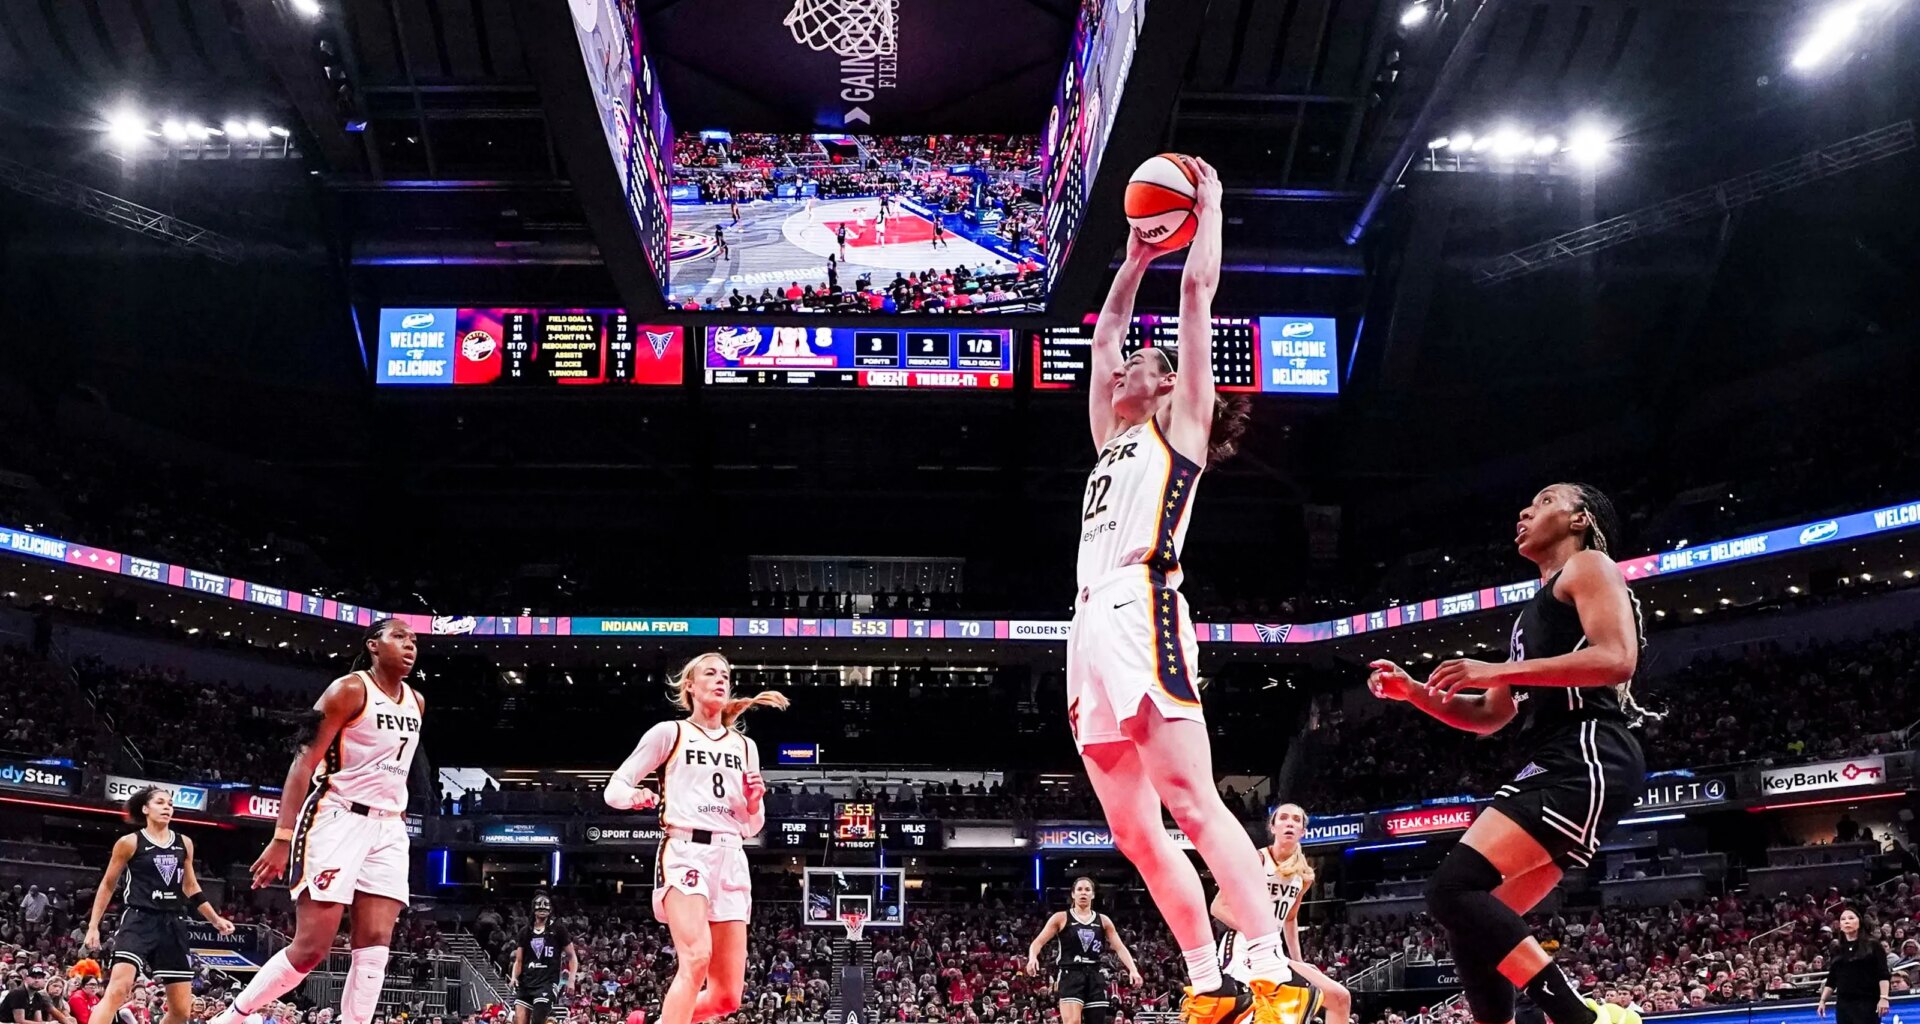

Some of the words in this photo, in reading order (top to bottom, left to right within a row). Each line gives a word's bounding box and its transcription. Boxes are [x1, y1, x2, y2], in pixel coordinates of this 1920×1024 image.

[390, 332, 446, 348] WELCOME
[542, 342, 578, 350] REBOUNDS
[871, 338, 882, 351] 3
[923, 339, 934, 352] 2
[967, 340, 992, 352] 1/3
[1271, 340, 1326, 358] WELCOME
[388, 360, 447, 376] DELICIOUS
[990, 374, 999, 387] 6
[1272, 368, 1330, 386] DELICIOUS
[1084, 475, 1112, 522] 22
[12, 533, 66, 558] DELICIOUS
[1660, 551, 1693, 571] COME
[1710, 536, 1768, 561] DELICIOUS
[130, 564, 158, 580] 6/23
[191, 577, 224, 594] 11/12
[251, 590, 282, 606] 18/58
[1502, 587, 1535, 604] 14/19
[308, 603, 316, 614] 7
[1442, 600, 1474, 615] 23/59
[342, 610, 354, 622] 13
[1408, 610, 1415, 621] 7
[602, 620, 650, 632] INDIANA
[652, 621, 688, 632] FEVER
[749, 620, 769, 634] 53
[852, 621, 886, 635] 5:53
[959, 622, 980, 636] 70
[1016, 626, 1057, 634] GOLDEN
[1370, 618, 1384, 629] 15
[914, 626, 922, 636] 4
[1217, 630, 1224, 640] 3
[376, 714, 419, 732] FEVER
[396, 737, 408, 762] 7
[686, 750, 743, 772] FEVER
[712, 772, 726, 798] 8
[1762, 770, 1838, 790] KeyBank
[249, 794, 280, 818] CHEE
[845, 804, 872, 816] 5:53
[782, 823, 806, 832] FEVER
[1387, 817, 1422, 830] STEAK
[1432, 812, 1471, 825] SHAKE
[602, 830, 630, 839] SPORT
[632, 831, 665, 839] GRAPHI
[902, 824, 926, 833] VALKS
[1304, 822, 1364, 840] HYUNDAI
[787, 834, 800, 844] 53
[912, 835, 924, 846] 70
[1273, 900, 1288, 920] 10
[217, 933, 246, 944] BANK
[544, 946, 554, 957] 15
[1438, 974, 1460, 984] Care
